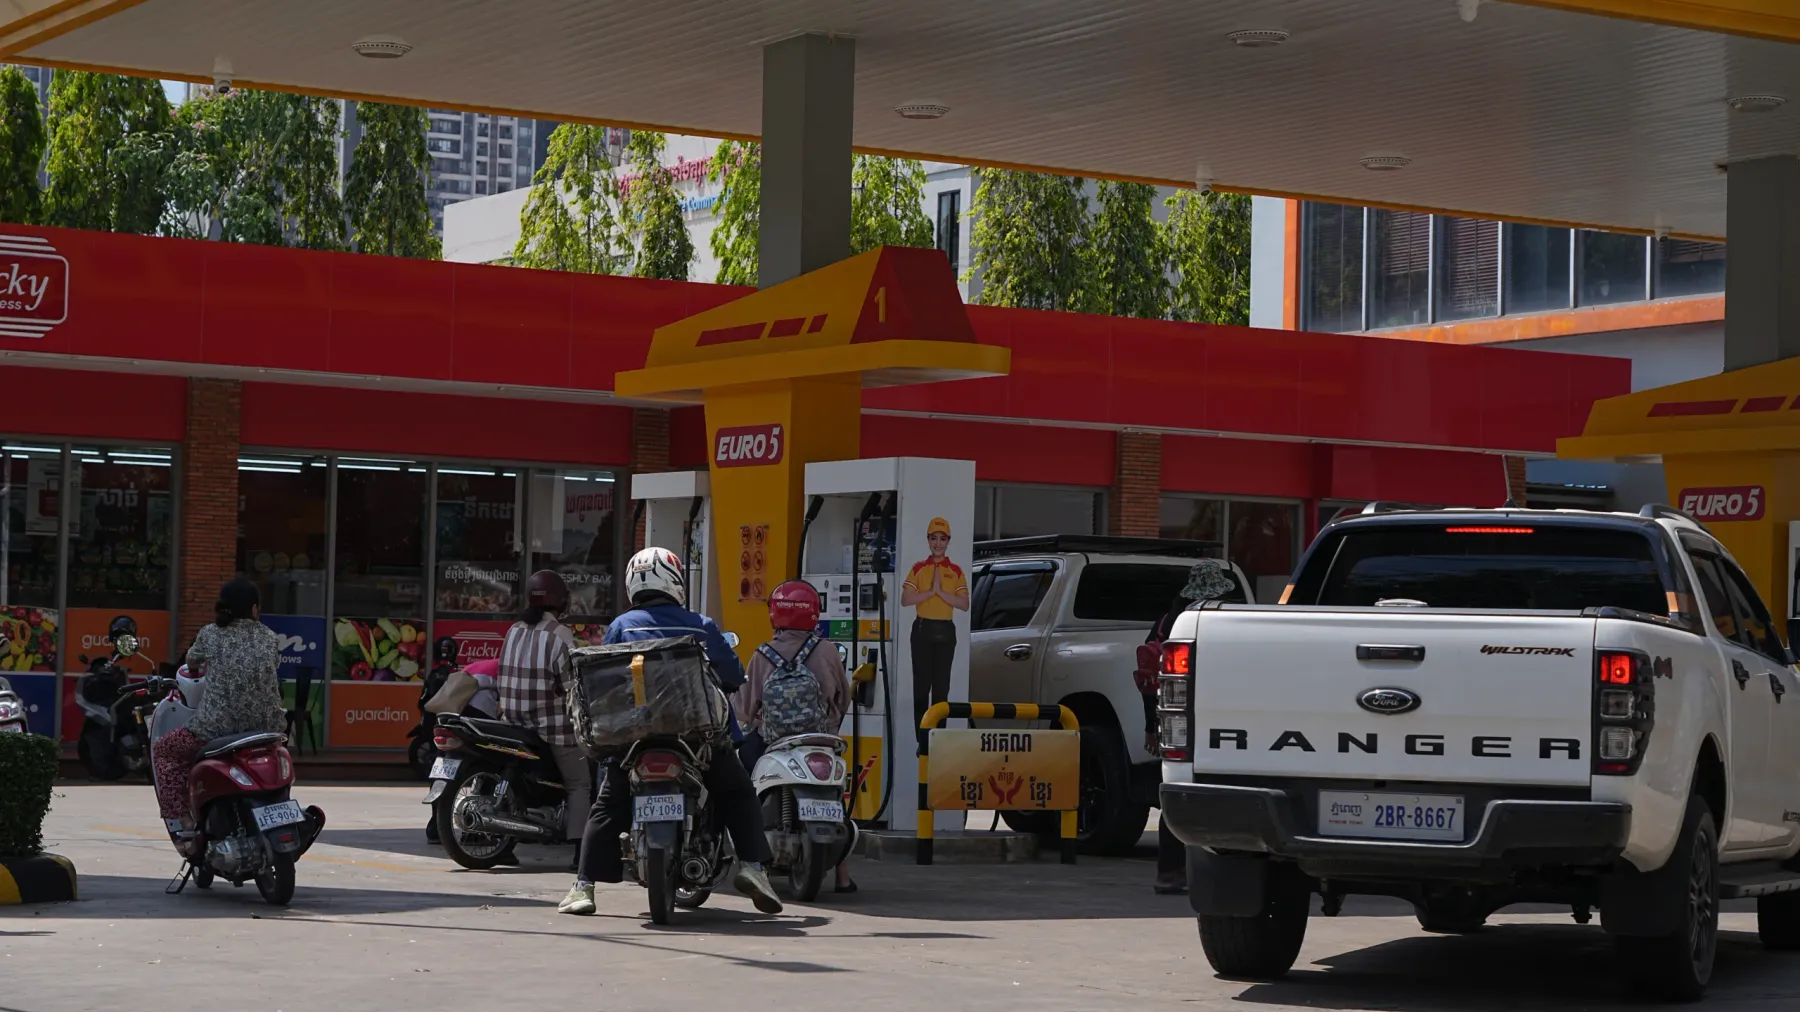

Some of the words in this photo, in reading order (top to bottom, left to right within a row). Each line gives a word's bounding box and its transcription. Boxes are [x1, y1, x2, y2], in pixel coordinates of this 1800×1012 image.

[874, 287, 886, 323] 1
[717, 434, 767, 461] EURO
[768, 426, 781, 460] 5
[1682, 493, 1743, 517] EURO
[1745, 488, 1760, 517] 5
[561, 573, 591, 583] ESHLY
[592, 574, 613, 584] BAK
[457, 640, 499, 660] Lucky
[1480, 645, 1576, 657] WILDTRAK
[1372, 693, 1399, 706] Ford
[345, 706, 409, 724] guardian
[980, 733, 1031, 763] អរគុណ
[1209, 728, 1581, 760] RANGER
[1331, 802, 1362, 817] ភ្នំពេញ
[1375, 804, 1456, 829] 2BR-8667
